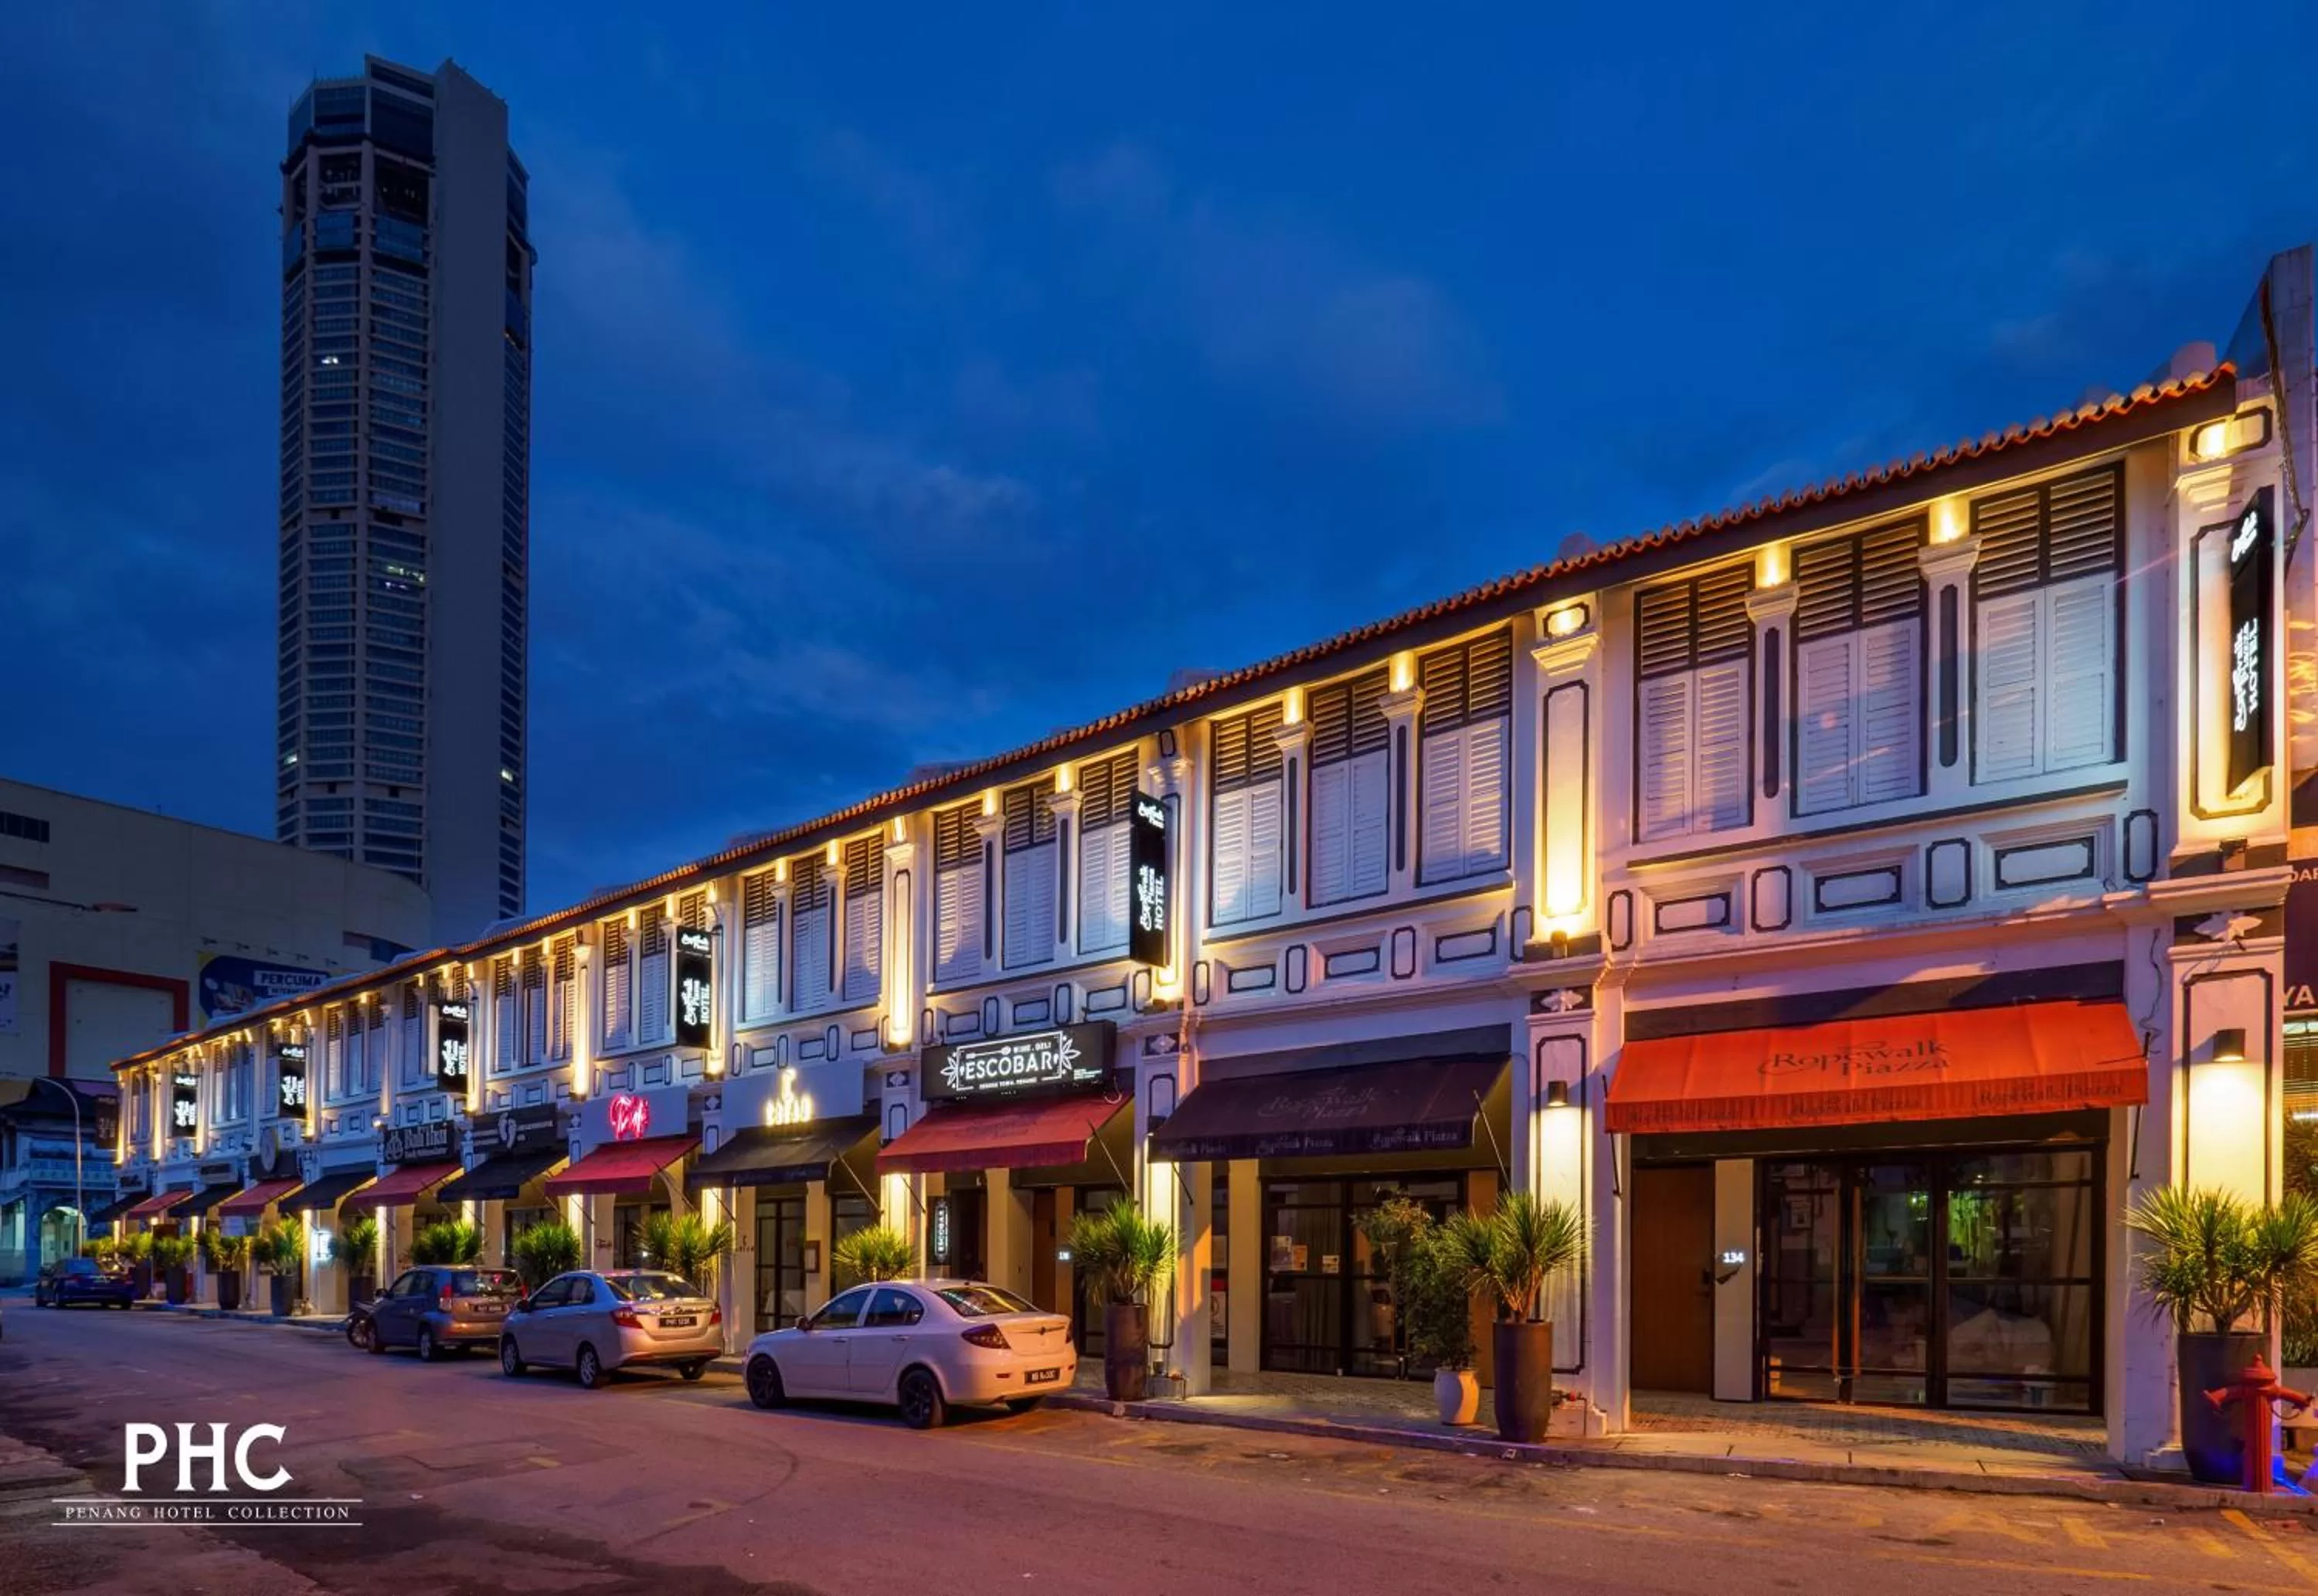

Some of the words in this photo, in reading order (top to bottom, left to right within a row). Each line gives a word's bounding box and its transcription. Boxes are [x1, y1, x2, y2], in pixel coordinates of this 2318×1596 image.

[1154, 875, 1164, 930] HOTEL
[260, 973, 321, 986] PERCUMA
[700, 983, 710, 1025] HOTEL
[966, 1051, 1052, 1080] ESCOBAR
[1758, 1040, 1950, 1075] Ropewalk
[1842, 1058, 1949, 1076] Piazza
[1723, 1251, 1745, 1263] 134
